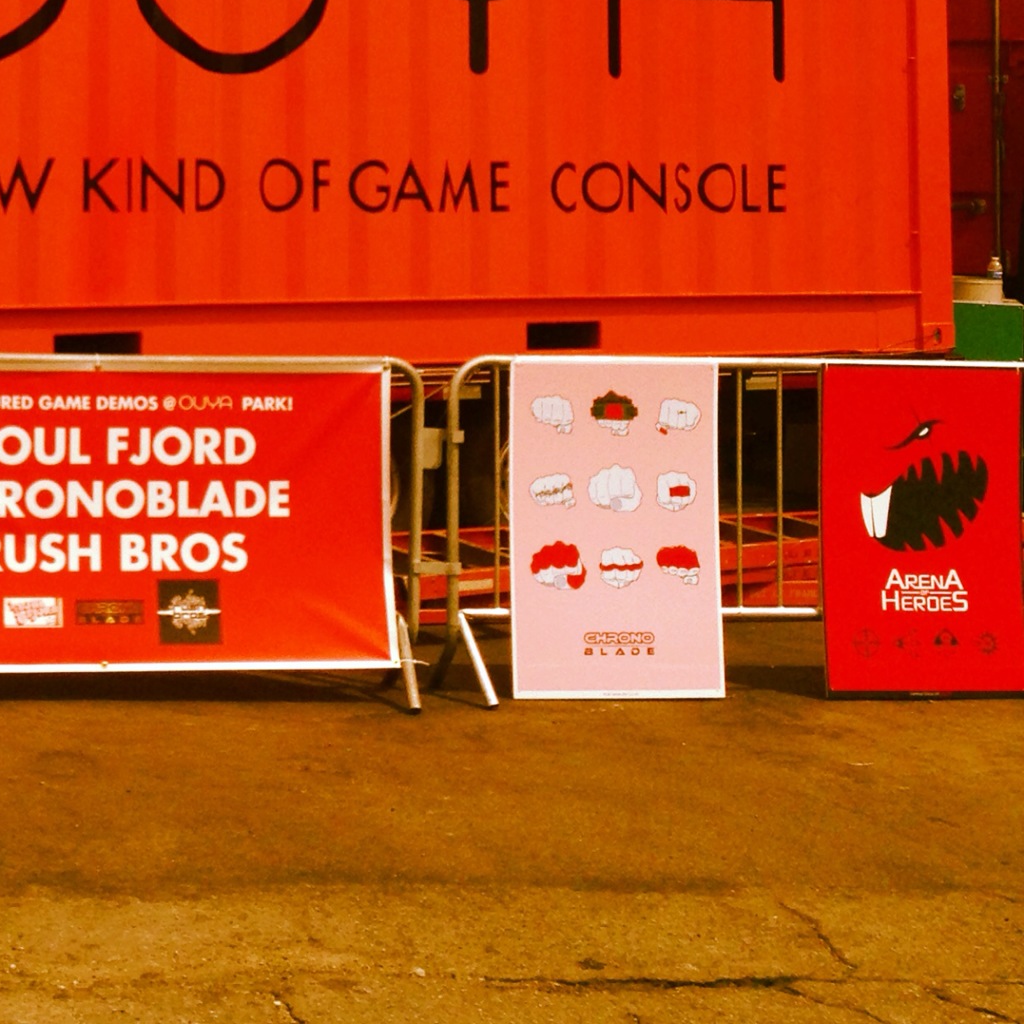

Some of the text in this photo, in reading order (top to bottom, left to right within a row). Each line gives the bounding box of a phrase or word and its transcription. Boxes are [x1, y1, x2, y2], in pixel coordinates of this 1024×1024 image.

[82, 155, 226, 215] KIND
[259, 157, 331, 214] OF
[347, 158, 510, 214] GAME
[550, 159, 787, 215] CONSOLE
[38, 394, 91, 412] GAME
[95, 394, 159, 412] DEMOS
[242, 396, 294, 412] PARK!
[107, 426, 257, 466] FJORD
[119, 531, 249, 573] BROS
[884, 568, 964, 590] ARENA
[880, 590, 969, 612] HEROES
[583, 631, 656, 645] CHRONO
[583, 647, 656, 656] BLADE
